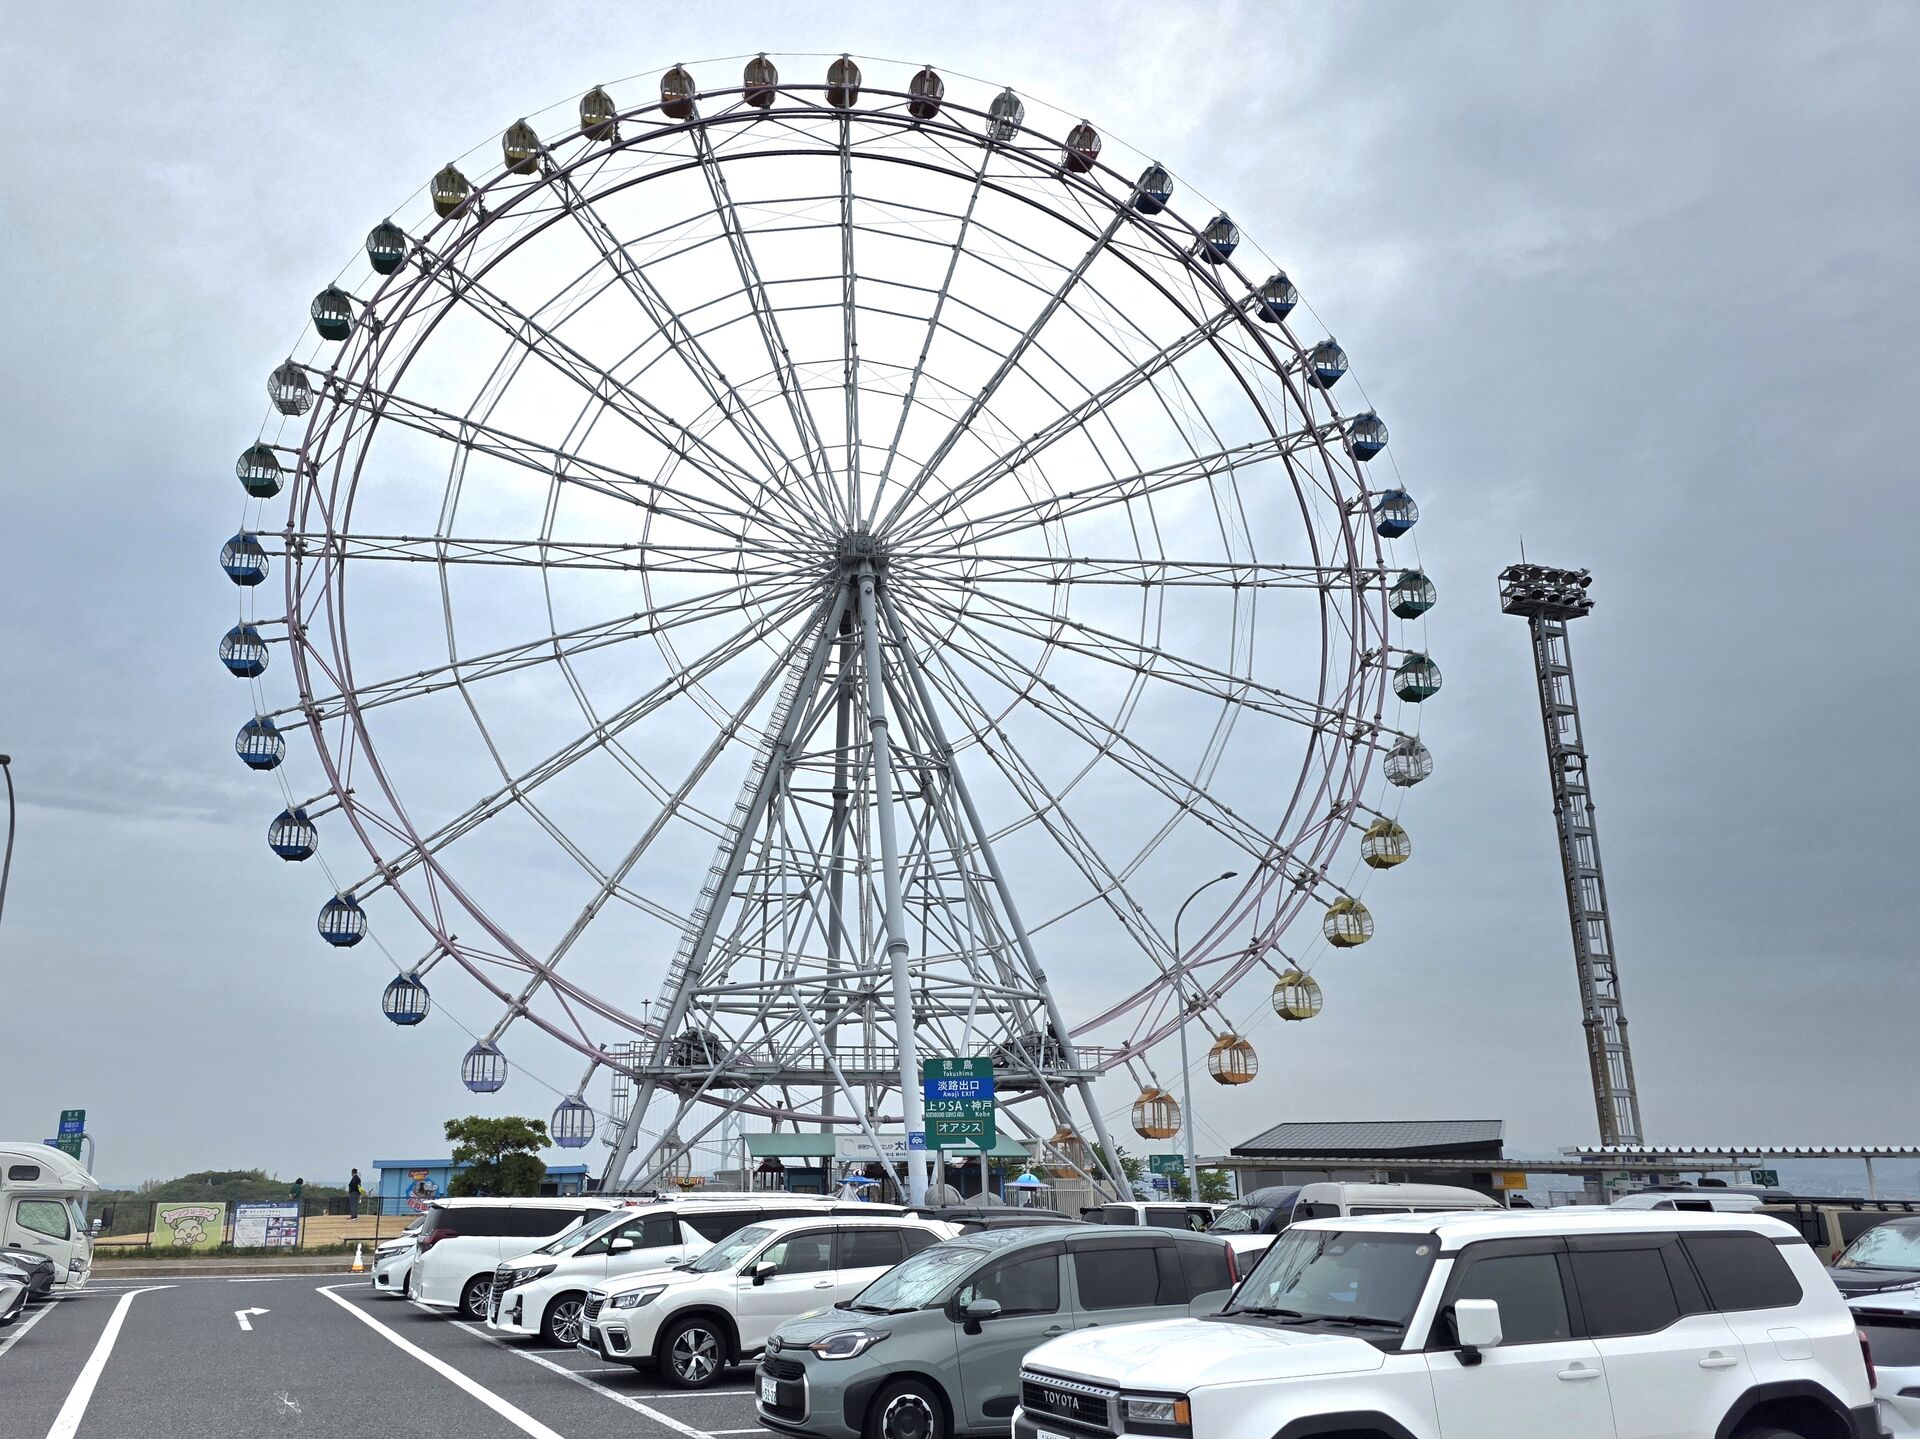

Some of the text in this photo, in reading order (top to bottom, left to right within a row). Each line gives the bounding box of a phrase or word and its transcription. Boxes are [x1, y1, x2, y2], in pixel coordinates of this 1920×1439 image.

[943, 1060, 973, 1070] 徳島
[937, 1080, 979, 1091] 淡路出口
[939, 1122, 981, 1132] オアシス
[1152, 1156, 1160, 1172] P
[1753, 1171, 1762, 1184] P
[1043, 1390, 1080, 1409] TOYOTA
